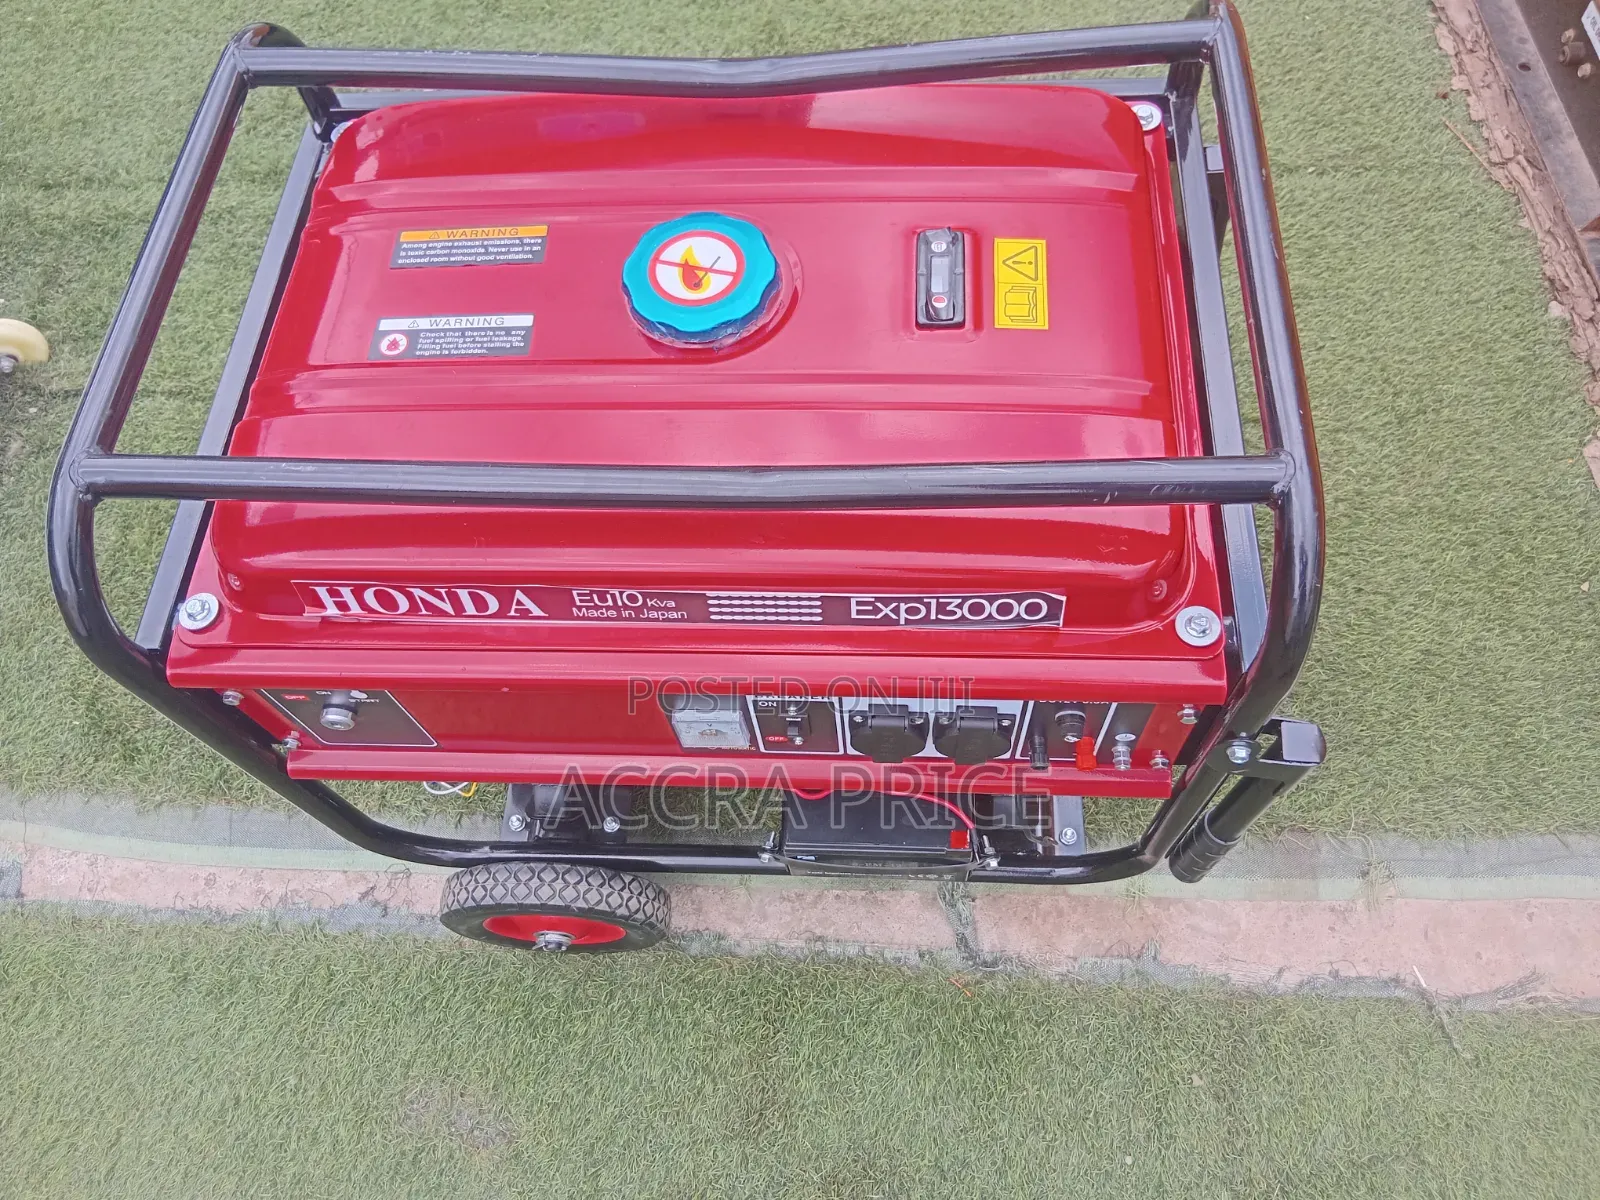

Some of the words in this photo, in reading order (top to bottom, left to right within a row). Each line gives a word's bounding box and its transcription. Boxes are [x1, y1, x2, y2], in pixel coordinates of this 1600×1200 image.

[446, 228, 519, 239] WARNING
[428, 240, 453, 248] engine
[425, 247, 450, 255] carbon
[397, 256, 430, 264] enclosed
[449, 254, 476, 262] without
[476, 254, 495, 262] good
[495, 252, 534, 260] ventilation.
[429, 316, 505, 327] WARNING
[308, 585, 549, 618] HONDA
[571, 589, 643, 608] Eu10
[646, 598, 676, 609] Kva
[572, 607, 618, 618] Made
[621, 607, 636, 618] in
[640, 609, 688, 621] Japan
[850, 597, 1048, 625] Exp13000
